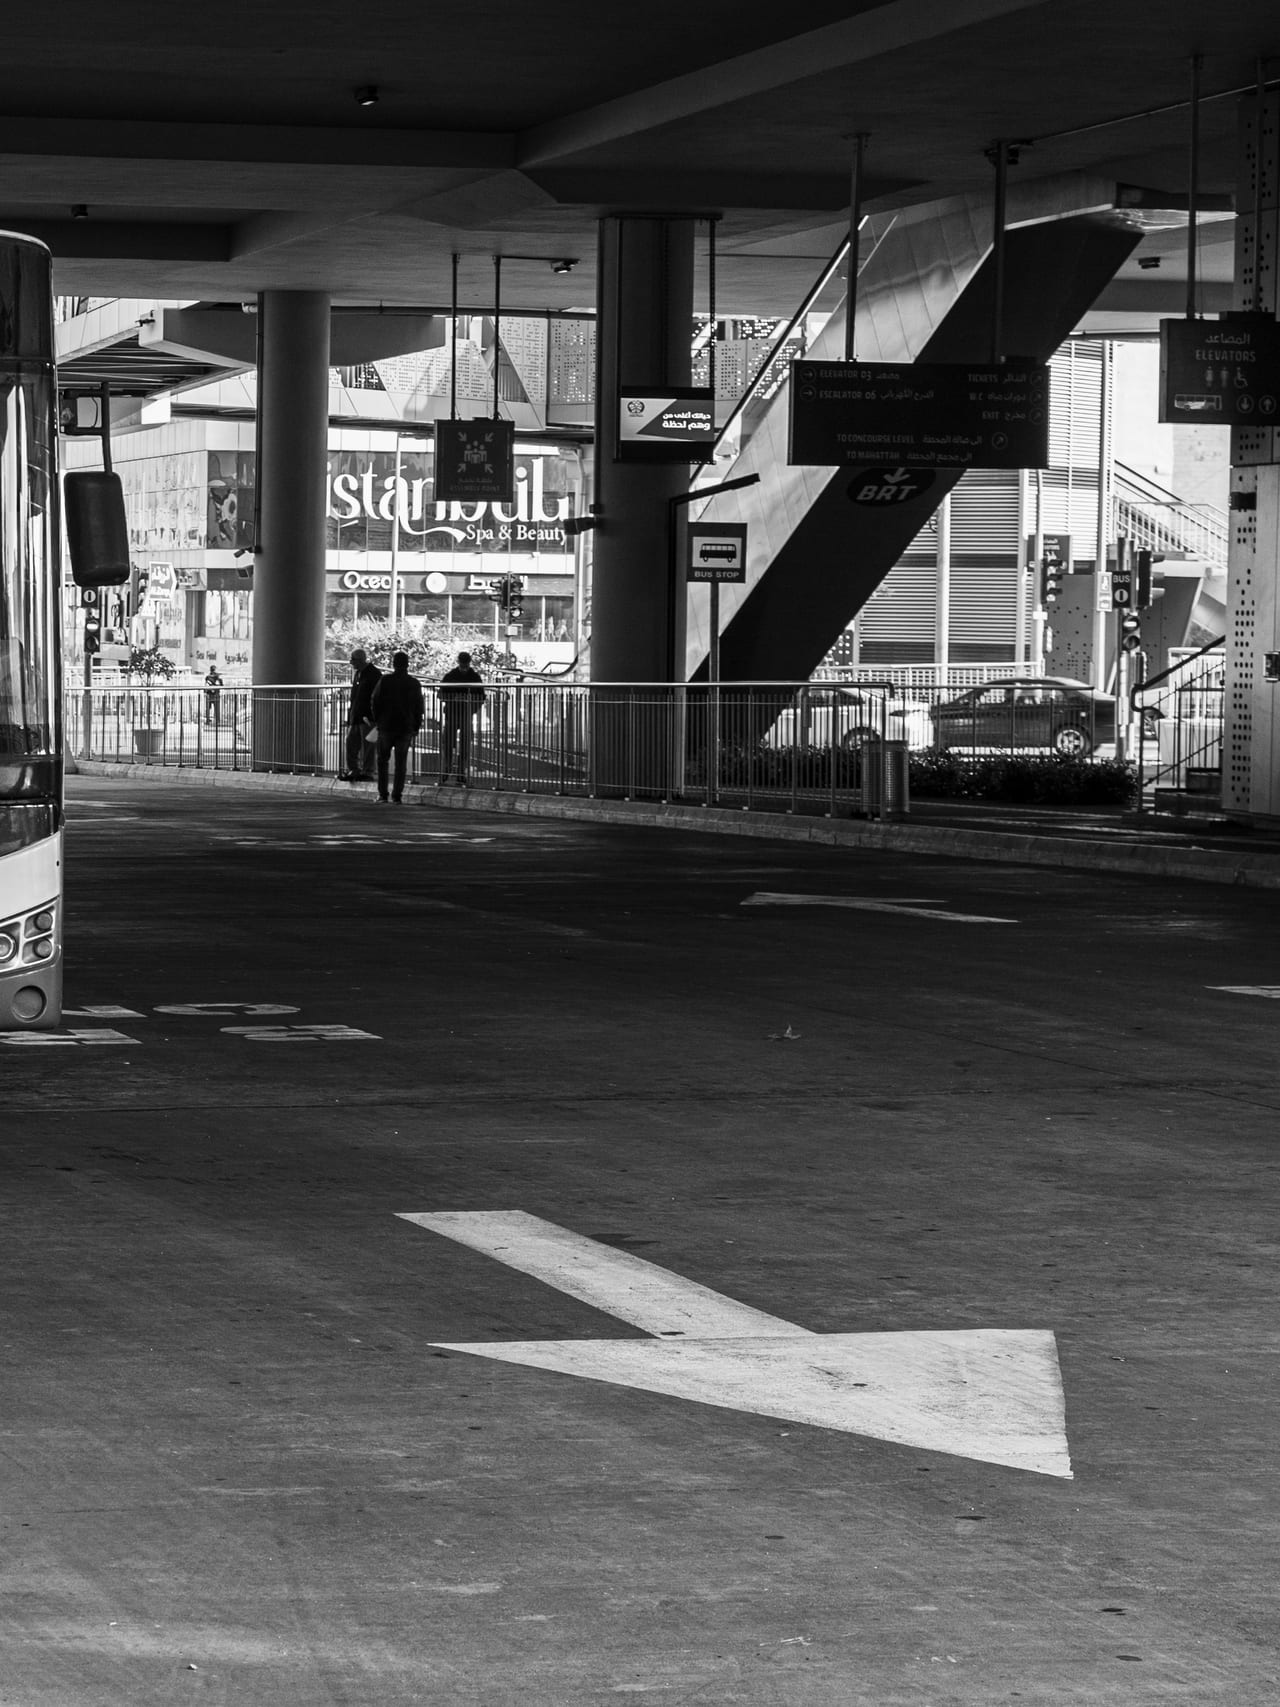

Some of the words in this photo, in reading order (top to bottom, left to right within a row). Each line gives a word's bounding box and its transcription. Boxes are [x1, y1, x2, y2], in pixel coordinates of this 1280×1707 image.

[1194, 349, 1257, 362] ELEVATORS
[968, 372, 999, 383] TICKETS
[855, 484, 918, 501] BRT
[466, 524, 493, 544] Spa
[498, 525, 512, 541] &
[516, 524, 568, 546] Beauty
[694, 570, 713, 578] BUS
[715, 570, 740, 579] STOP
[1112, 574, 1131, 583] BUS
